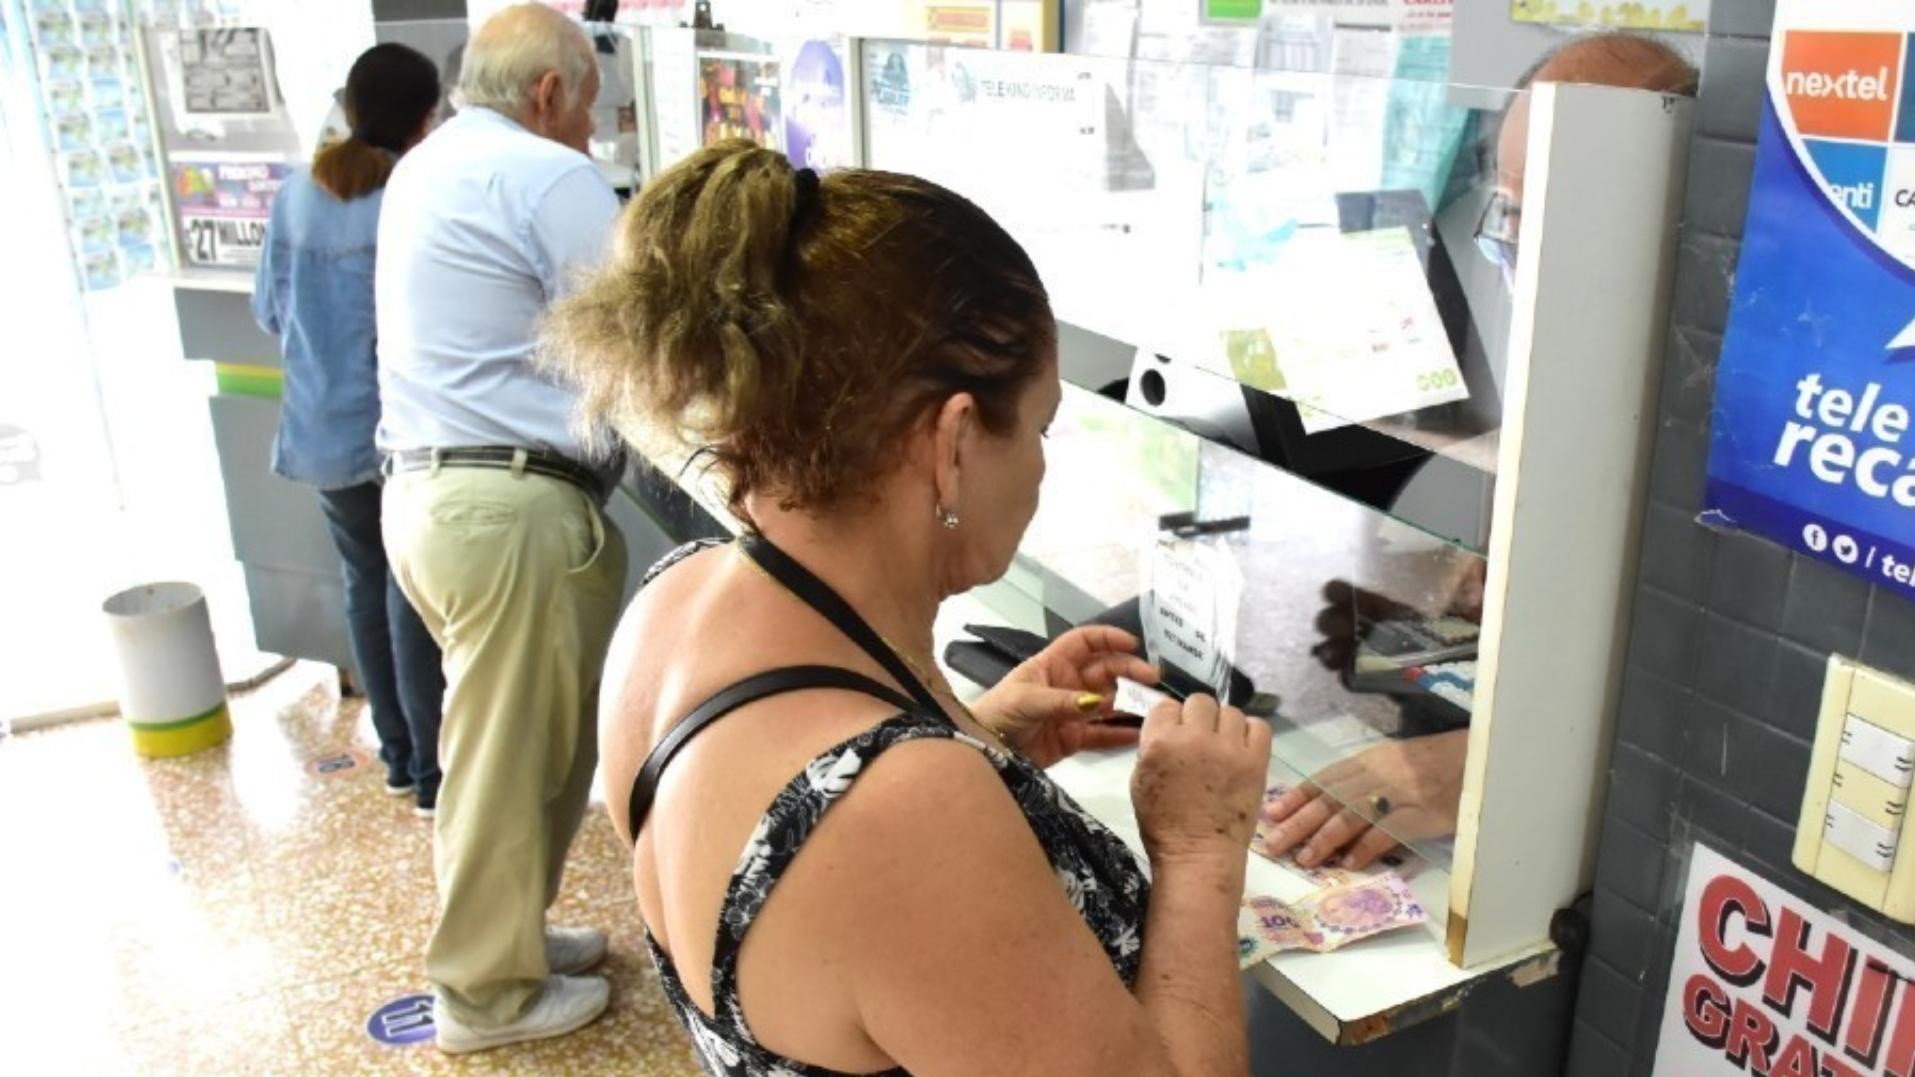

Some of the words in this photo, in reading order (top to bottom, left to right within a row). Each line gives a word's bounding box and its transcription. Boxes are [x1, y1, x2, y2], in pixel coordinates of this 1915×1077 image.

[1785, 66, 1889, 101] nextel
[1794, 372, 1910, 443] tele
[381, 1000, 435, 1039] 11
